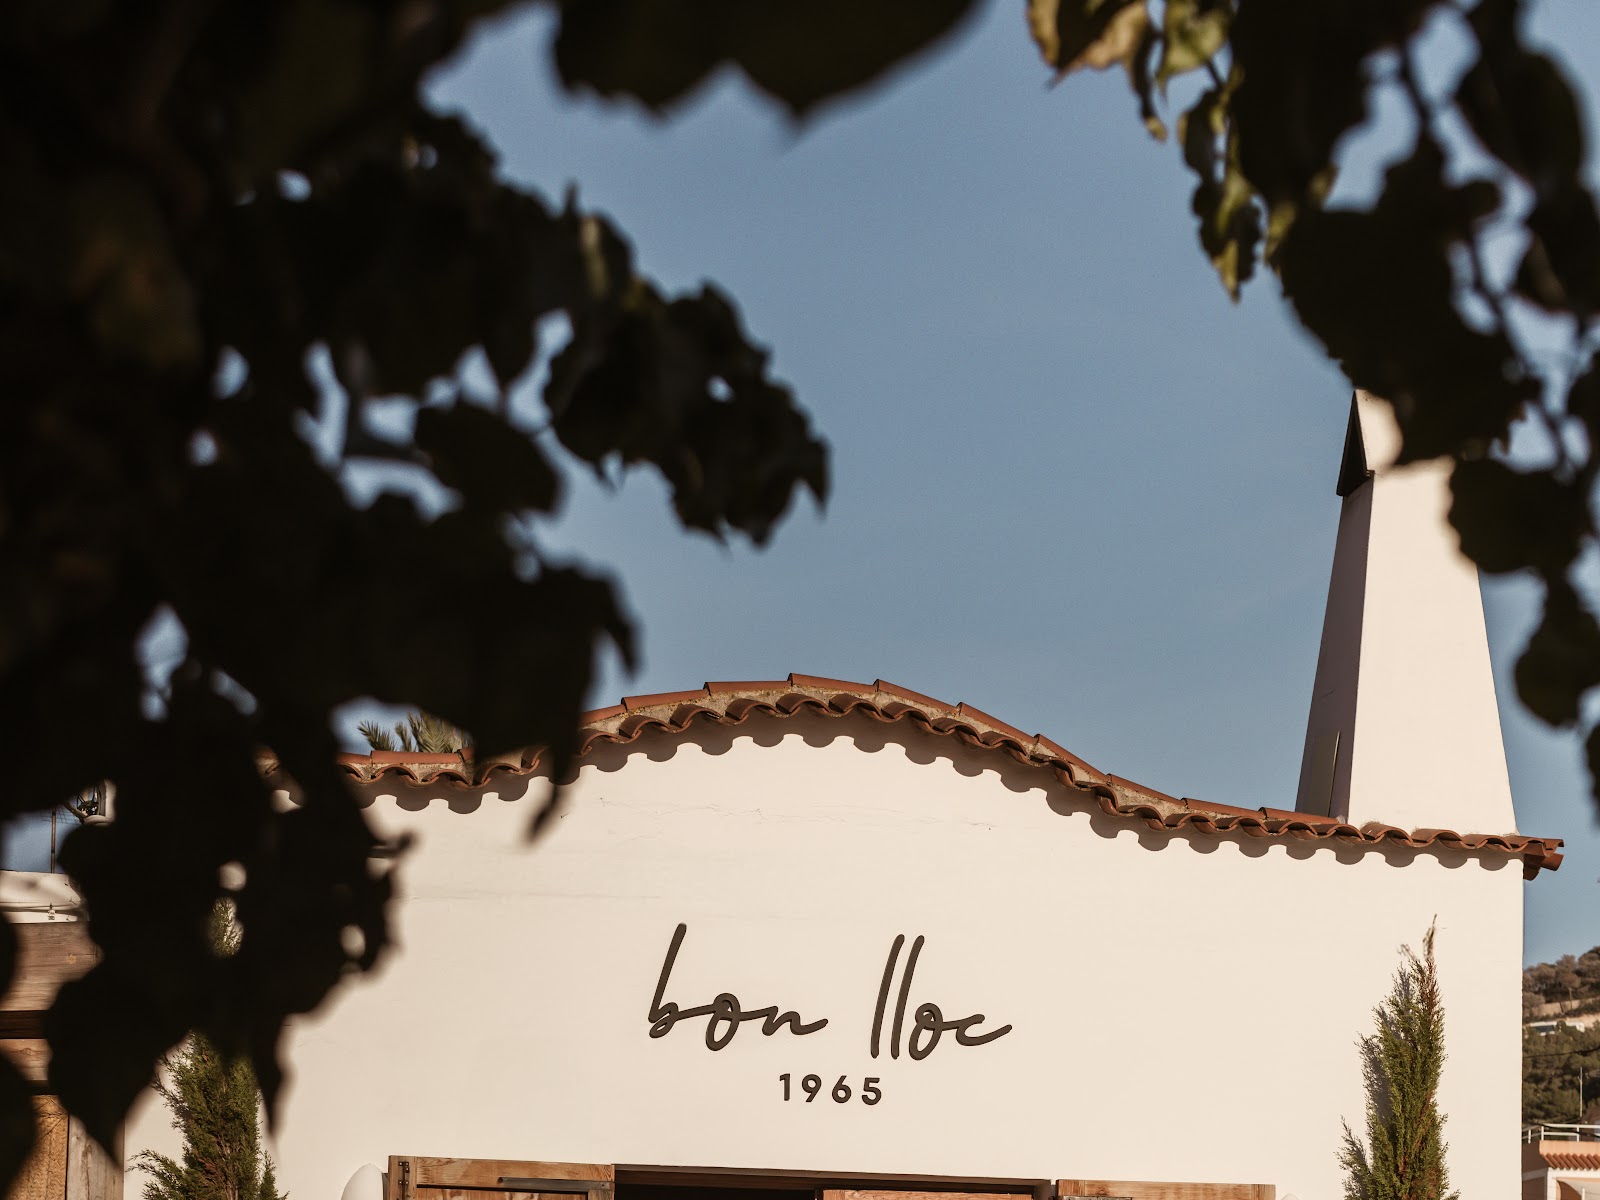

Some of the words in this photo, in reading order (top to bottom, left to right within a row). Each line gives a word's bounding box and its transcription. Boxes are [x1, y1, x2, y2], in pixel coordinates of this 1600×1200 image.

[648, 922, 829, 1051] bon
[870, 934, 1012, 1061] lloc
[779, 1073, 882, 1106] 1965
